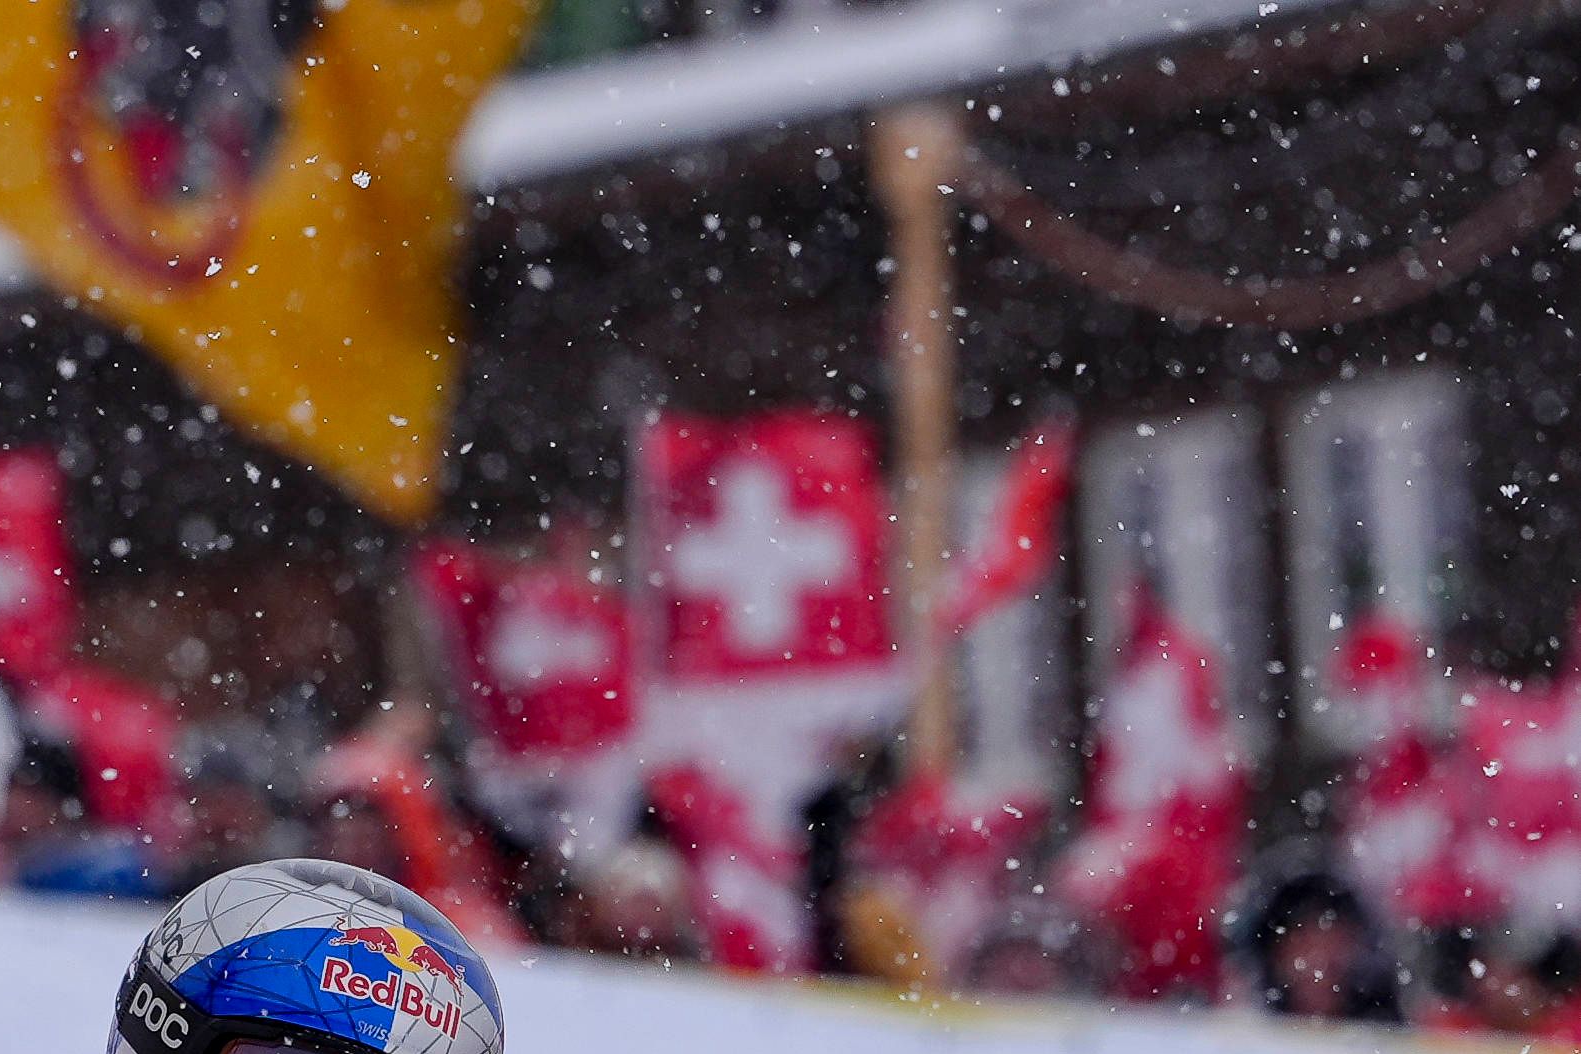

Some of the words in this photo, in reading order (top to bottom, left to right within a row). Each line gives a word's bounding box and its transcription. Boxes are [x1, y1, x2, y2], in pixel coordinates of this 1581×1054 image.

[128, 982, 189, 1049] POC
[321, 957, 399, 1008] Red
[399, 980, 462, 1041] Bull
